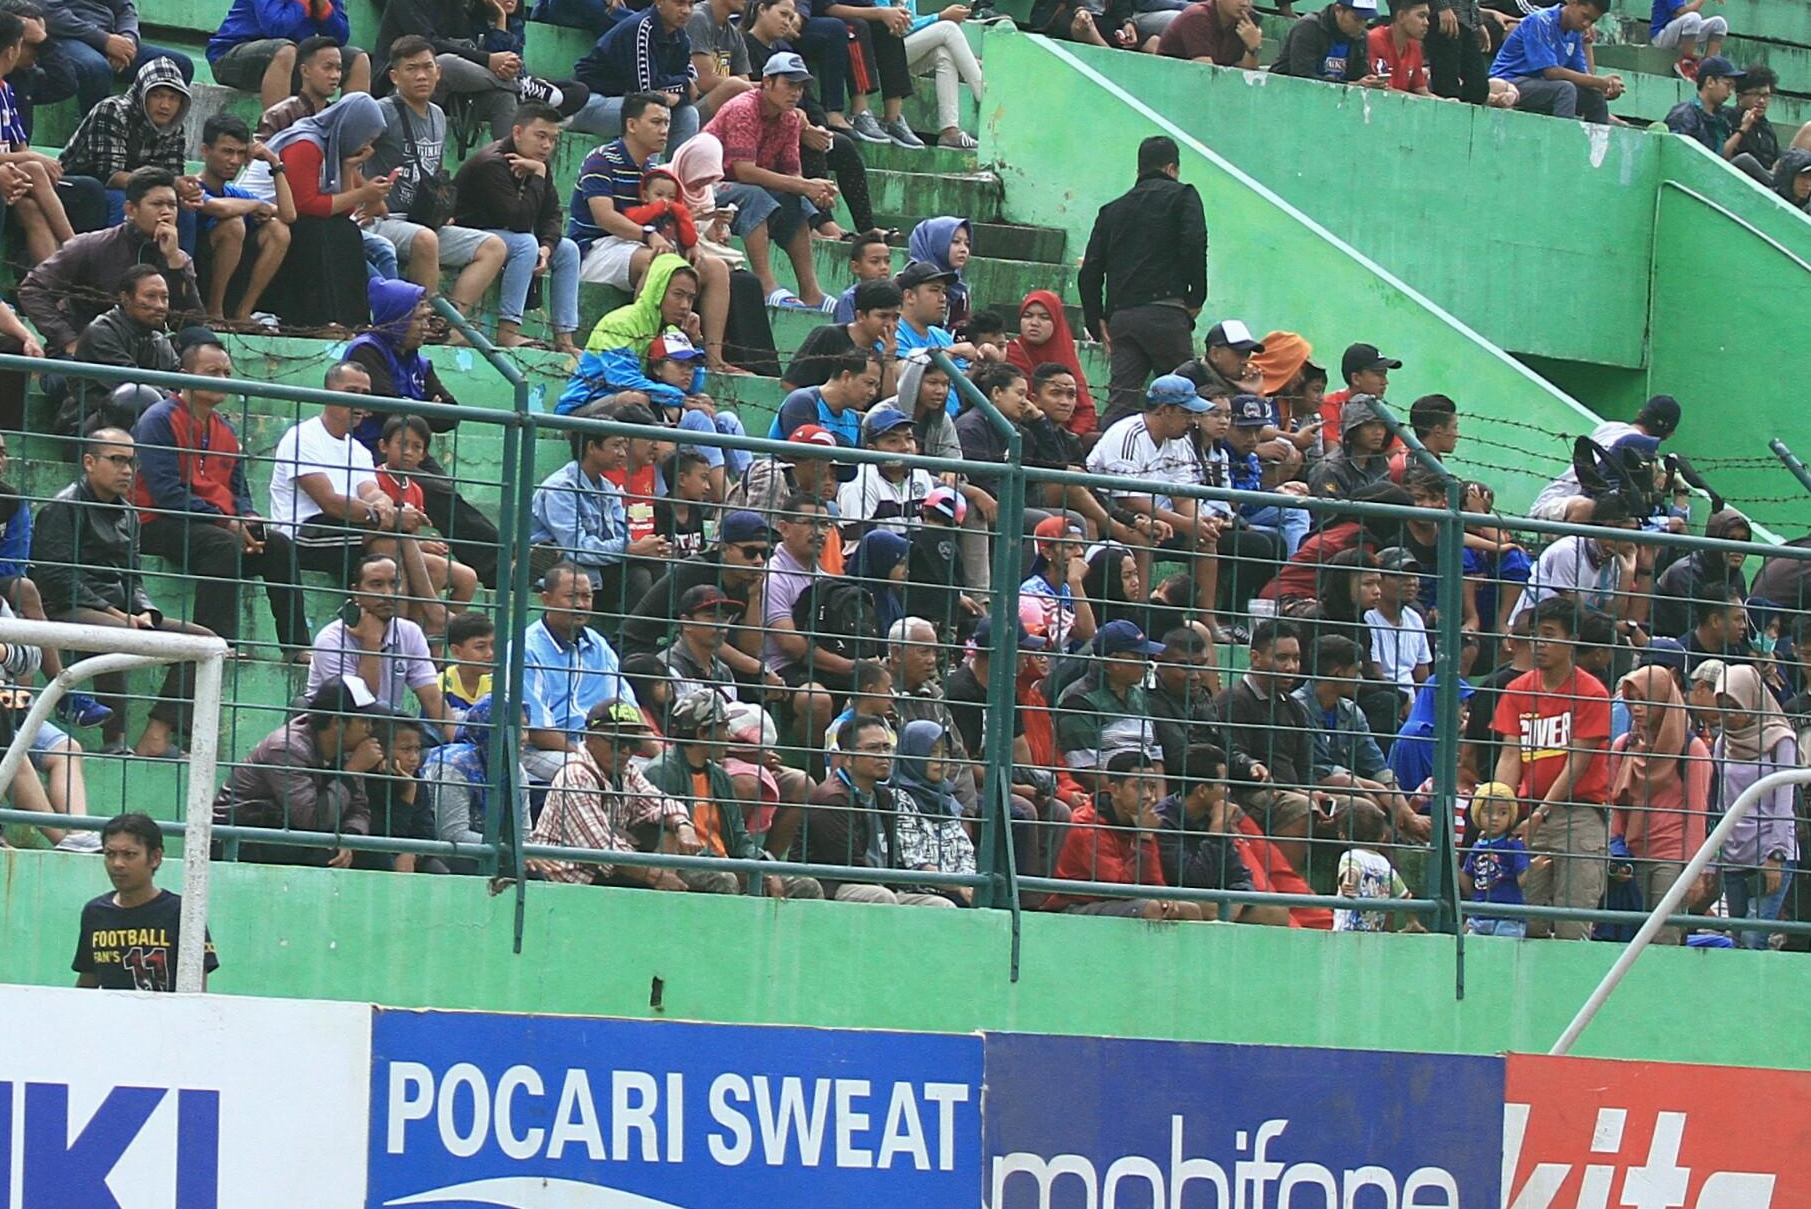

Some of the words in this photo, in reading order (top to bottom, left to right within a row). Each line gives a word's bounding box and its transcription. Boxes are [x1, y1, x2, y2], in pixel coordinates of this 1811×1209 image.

[92, 928, 171, 948] FOOTBALL
[93, 949, 122, 964] FAN'S
[122, 946, 170, 992] 11
[387, 1061, 683, 1163] POCARI
[707, 1073, 969, 1171] SWEAT
